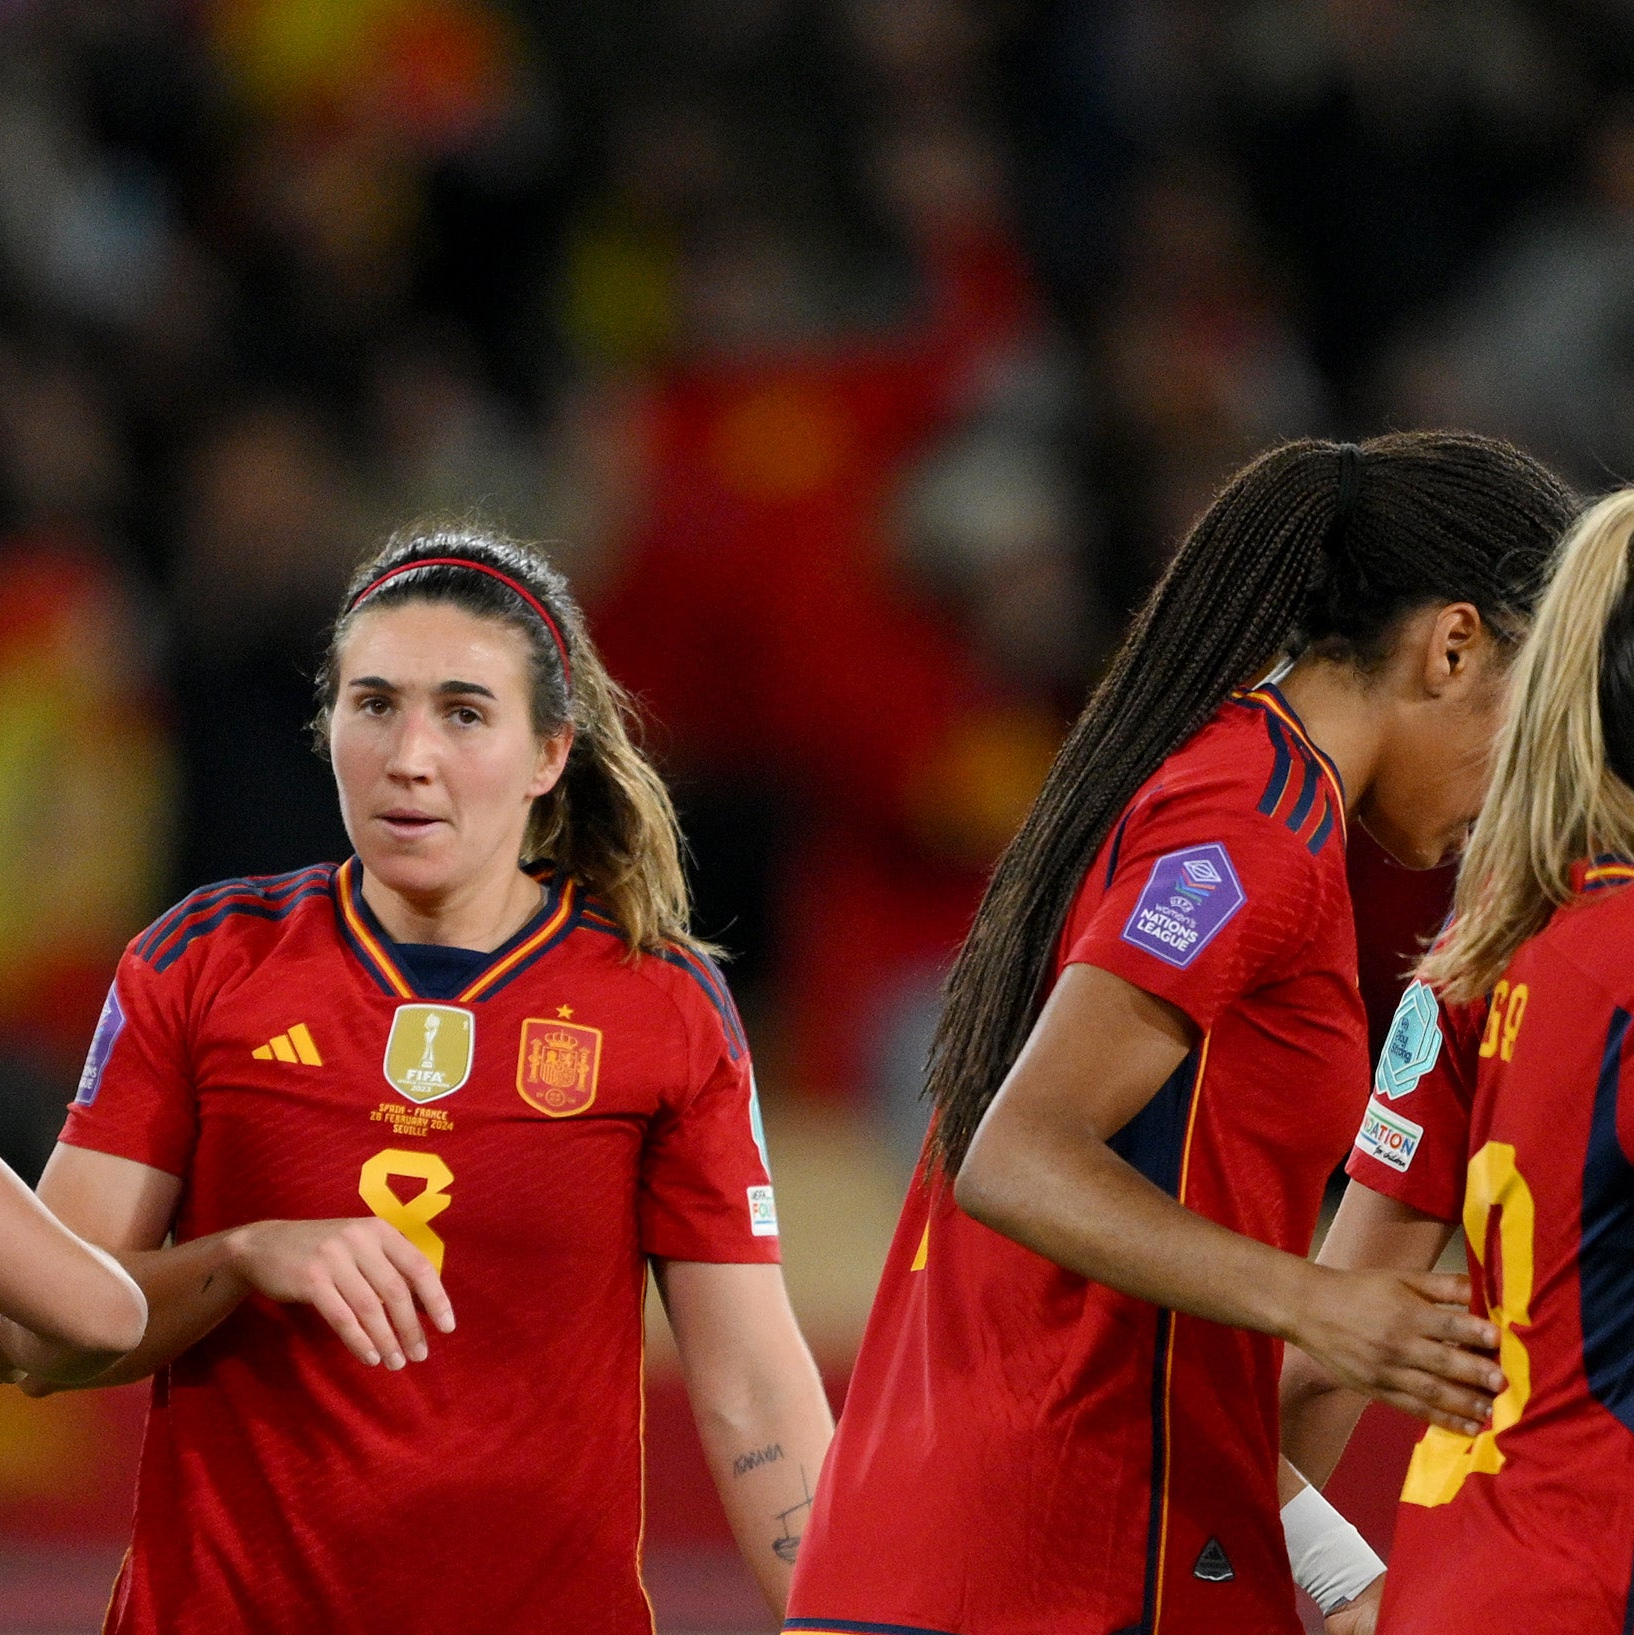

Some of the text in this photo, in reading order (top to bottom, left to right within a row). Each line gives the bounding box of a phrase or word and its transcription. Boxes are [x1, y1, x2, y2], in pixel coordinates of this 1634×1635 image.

[1137, 919, 1190, 952] LEAGUE
[1140, 908, 1199, 943] NATIONS
[406, 1069, 443, 1083] FIFA
[369, 1111, 455, 1132] 28 FEBRUARY 2024
[379, 1103, 404, 1114] SPAIN
[414, 1107, 449, 1121] FRANCE
[393, 1124, 428, 1137] SEVILLE
[358, 1148, 454, 1276] 8
